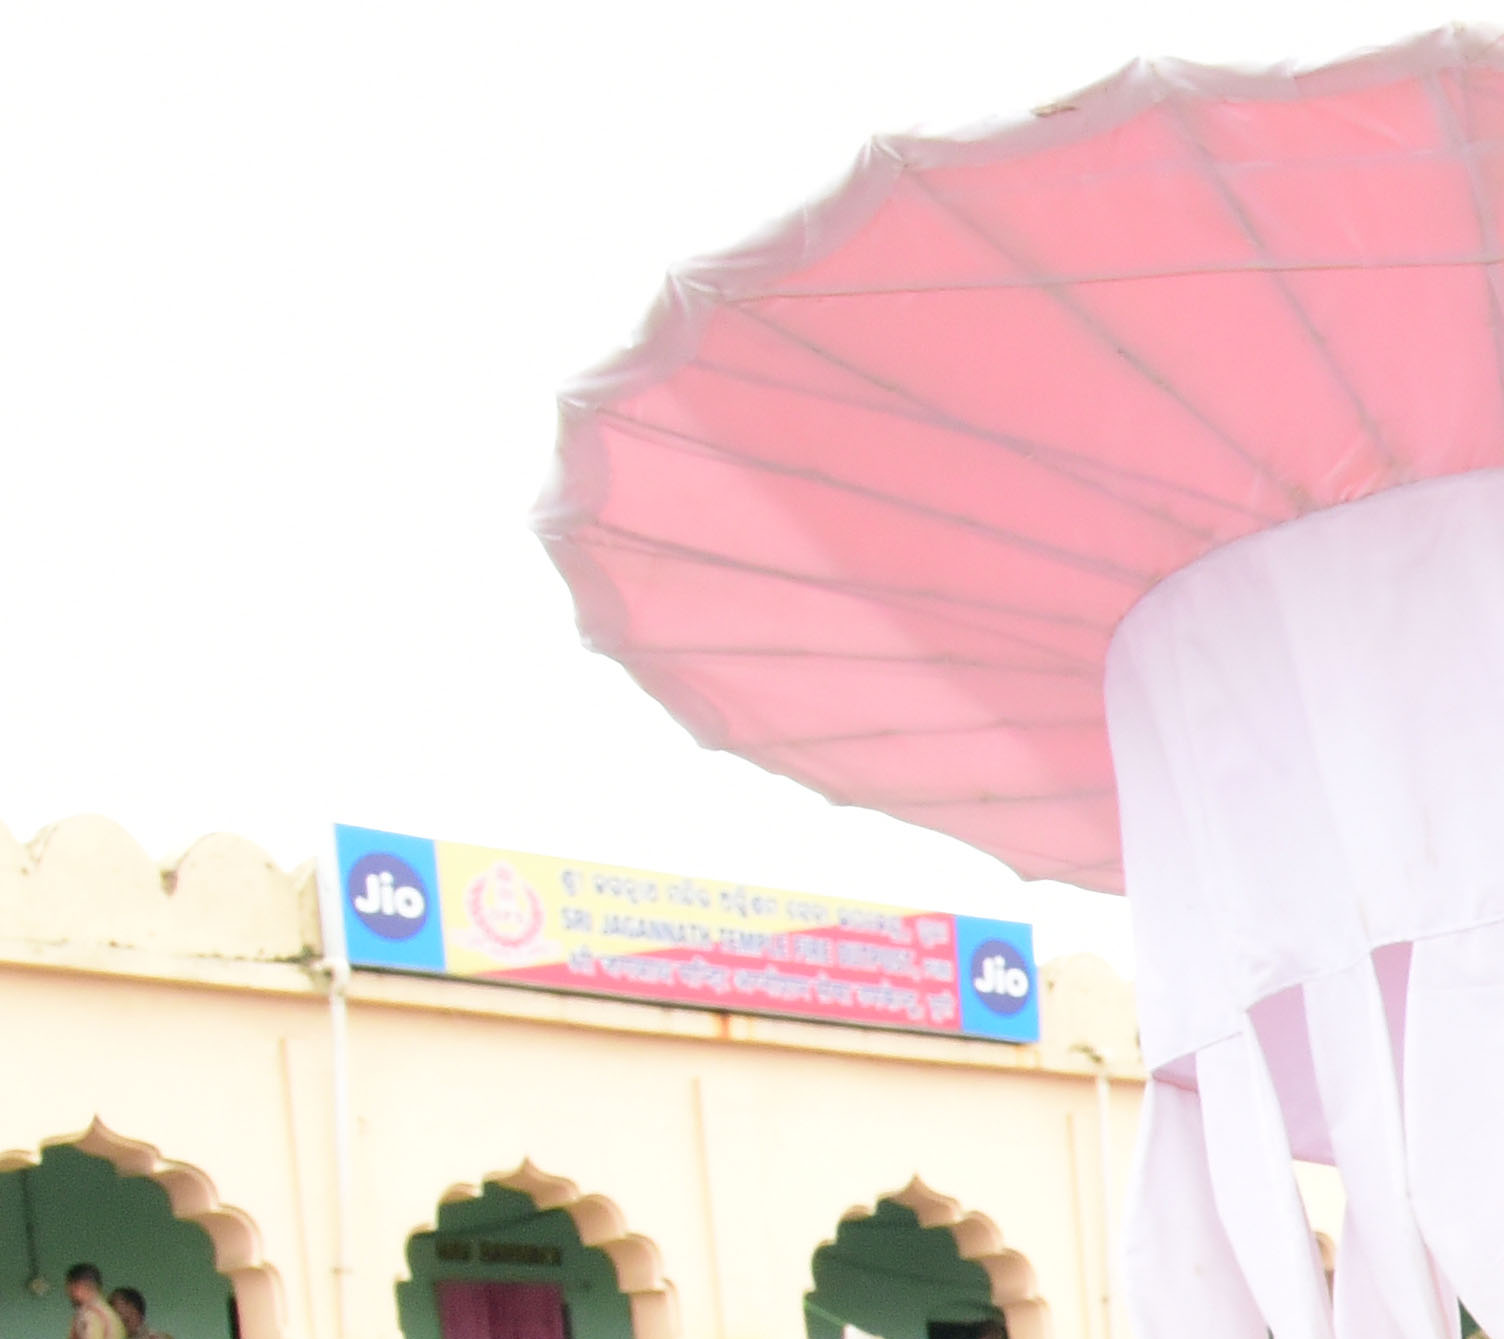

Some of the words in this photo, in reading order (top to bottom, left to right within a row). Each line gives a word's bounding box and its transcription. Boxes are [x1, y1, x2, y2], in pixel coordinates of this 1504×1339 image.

[353, 871, 425, 919] Jio
[560, 906, 592, 932] SRI
[601, 912, 712, 945] JAGANNATH
[717, 928, 787, 960] TEMPLE
[973, 955, 1029, 998] Jio
